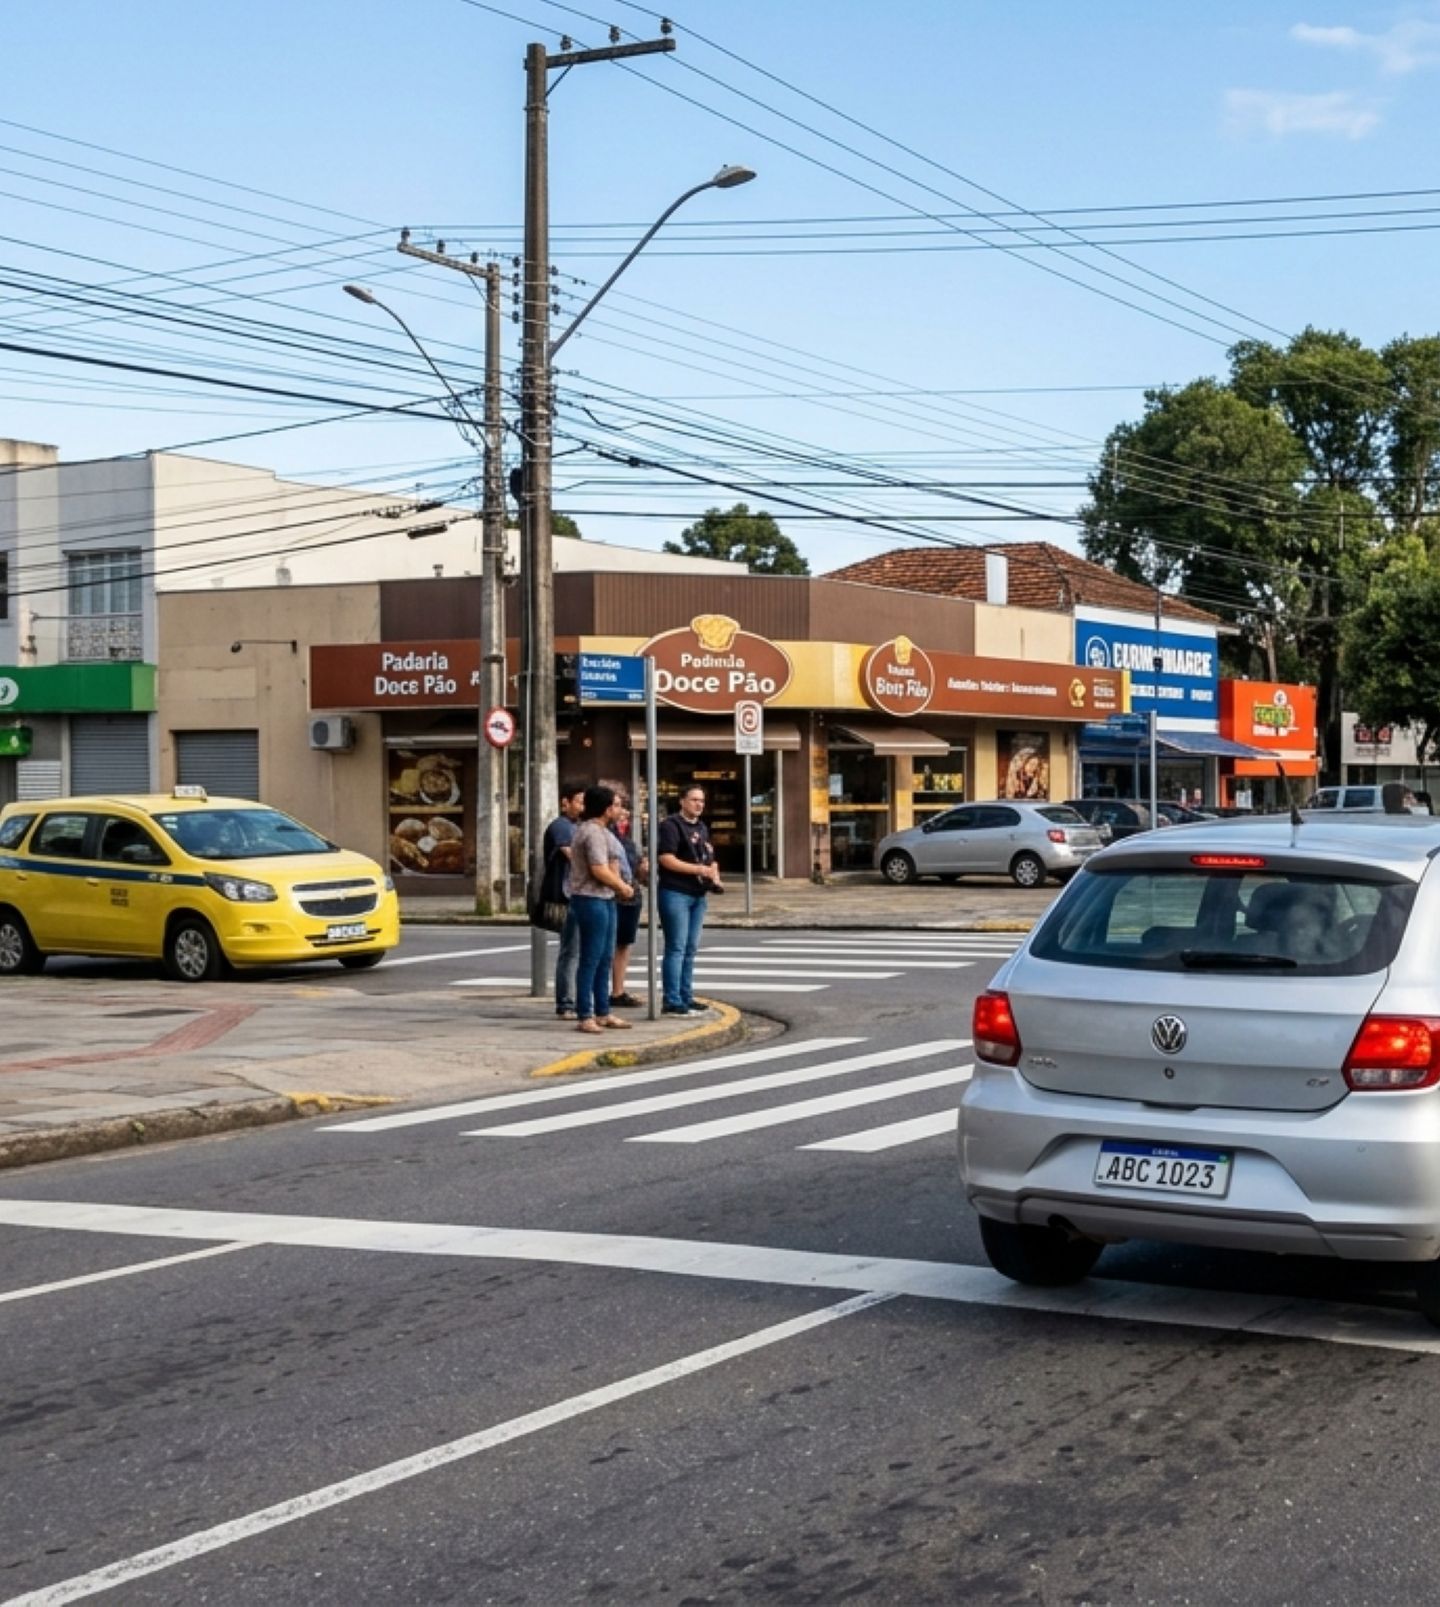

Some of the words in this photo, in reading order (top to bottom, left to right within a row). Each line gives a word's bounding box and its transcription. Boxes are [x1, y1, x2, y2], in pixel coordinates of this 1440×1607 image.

[382, 651, 449, 671] Padaria
[374, 676, 419, 695] Doce
[423, 674, 457, 694] Pão
[654, 669, 720, 693] Doce
[728, 670, 775, 694] Pão
[1156, 1160, 1216, 1188] 1023
